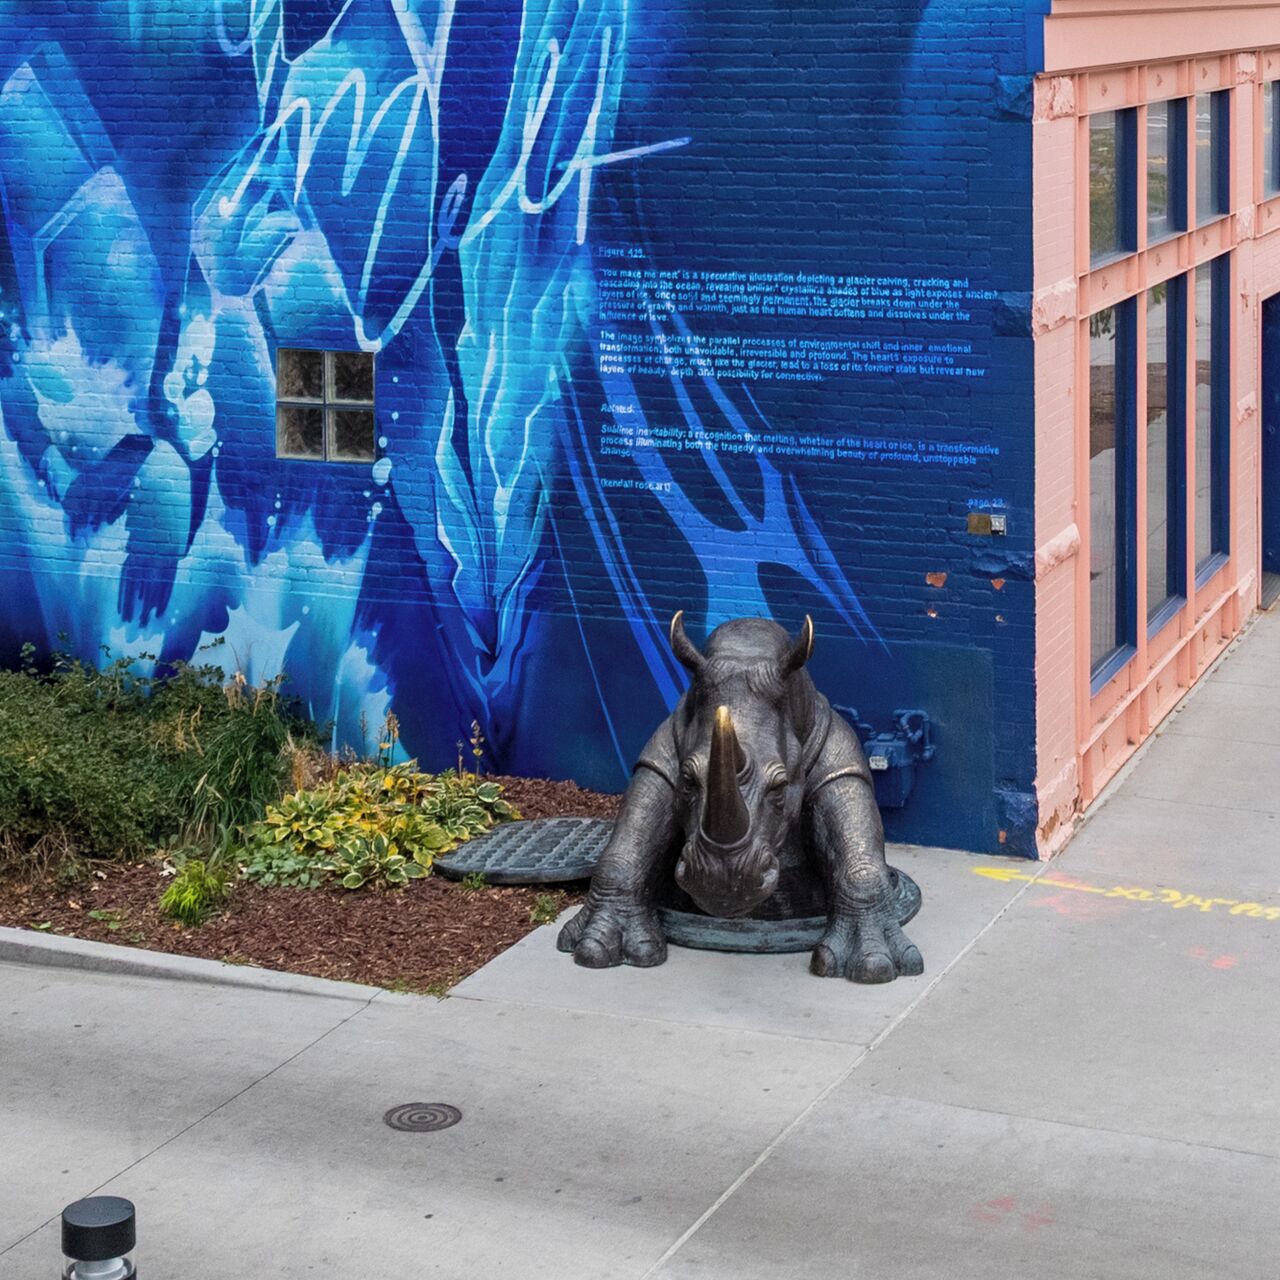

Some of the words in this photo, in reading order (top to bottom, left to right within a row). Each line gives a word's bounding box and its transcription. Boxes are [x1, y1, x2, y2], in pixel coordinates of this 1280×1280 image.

[620, 270, 641, 278] make
[701, 271, 746, 281] speculative
[750, 272, 794, 282] illustration
[797, 272, 835, 285] depicting
[846, 276, 875, 286] glacier
[953, 278, 968, 288] and
[599, 280, 639, 289] cascading
[642, 281, 657, 289] into
[660, 281, 673, 289] the
[706, 282, 744, 293] revealing
[827, 287, 858, 295] shades
[871, 288, 889, 296] blue
[905, 288, 924, 299] light
[927, 291, 962, 299] exposes
[966, 290, 998, 299] ancient
[599, 291, 624, 299] layers
[678, 292, 697, 300] solid
[701, 293, 716, 302] and
[719, 294, 760, 304] seemingly
[830, 297, 859, 307] glacier
[861, 298, 890, 307] breaks
[893, 298, 915, 307] down
[919, 299, 943, 308] under
[946, 299, 959, 308] the
[599, 312, 636, 320] influence
[648, 302, 675, 312] gravity
[732, 304, 747, 314] just
[762, 305, 775, 314] the
[778, 306, 806, 315] human
[809, 307, 832, 316] heart
[834, 307, 865, 318] softens
[868, 309, 883, 317] and
[887, 309, 927, 319] dissolves
[929, 310, 953, 320] under
[956, 311, 970, 321] the
[618, 332, 642, 343] image
[645, 333, 691, 344] symbolizes
[694, 335, 706, 344] the
[709, 337, 740, 346] parallel
[743, 338, 786, 348] processes
[788, 338, 796, 347] of
[799, 340, 859, 350] environmental
[862, 341, 880, 349] shift
[883, 342, 899, 351] and
[928, 344, 971, 353] emotional
[664, 344, 681, 354] both
[740, 348, 787, 357] irreversible
[790, 350, 805, 358] and
[903, 355, 942, 364] exposure
[944, 355, 953, 364] to
[600, 355, 641, 365] processes
[690, 357, 712, 366] much
[715, 358, 729, 367] like
[732, 358, 745, 367] the
[781, 360, 799, 369] lead
[820, 362, 838, 371] loss
[841, 362, 850, 371] of
[852, 363, 863, 371] its
[865, 364, 893, 372] former
[896, 365, 916, 373] state
[920, 366, 934, 375] but
[936, 367, 963, 376] reveal
[966, 368, 984, 376] new
[600, 366, 624, 374] layers
[628, 366, 635, 374] of
[671, 367, 693, 377] depth
[698, 368, 714, 376] and
[717, 369, 758, 380] possibility
[761, 370, 773, 378] for
[601, 425, 633, 435] Sublime
[695, 430, 741, 440] recognition
[744, 433, 760, 442] that
[800, 437, 833, 447] whether
[836, 438, 846, 447] of
[847, 439, 860, 448] the
[864, 440, 886, 449] heart
[889, 442, 898, 450] or
[919, 441, 925, 450] is
[937, 443, 999, 455] transformative
[601, 436, 632, 447] process
[636, 438, 682, 449] illuminating
[685, 440, 703, 449] both
[706, 441, 718, 449] the
[758, 444, 773, 453] and
[776, 445, 834, 459] overwhelming
[837, 448, 865, 460] beauty
[868, 451, 877, 460] of
[924, 454, 976, 466] unstoppable
